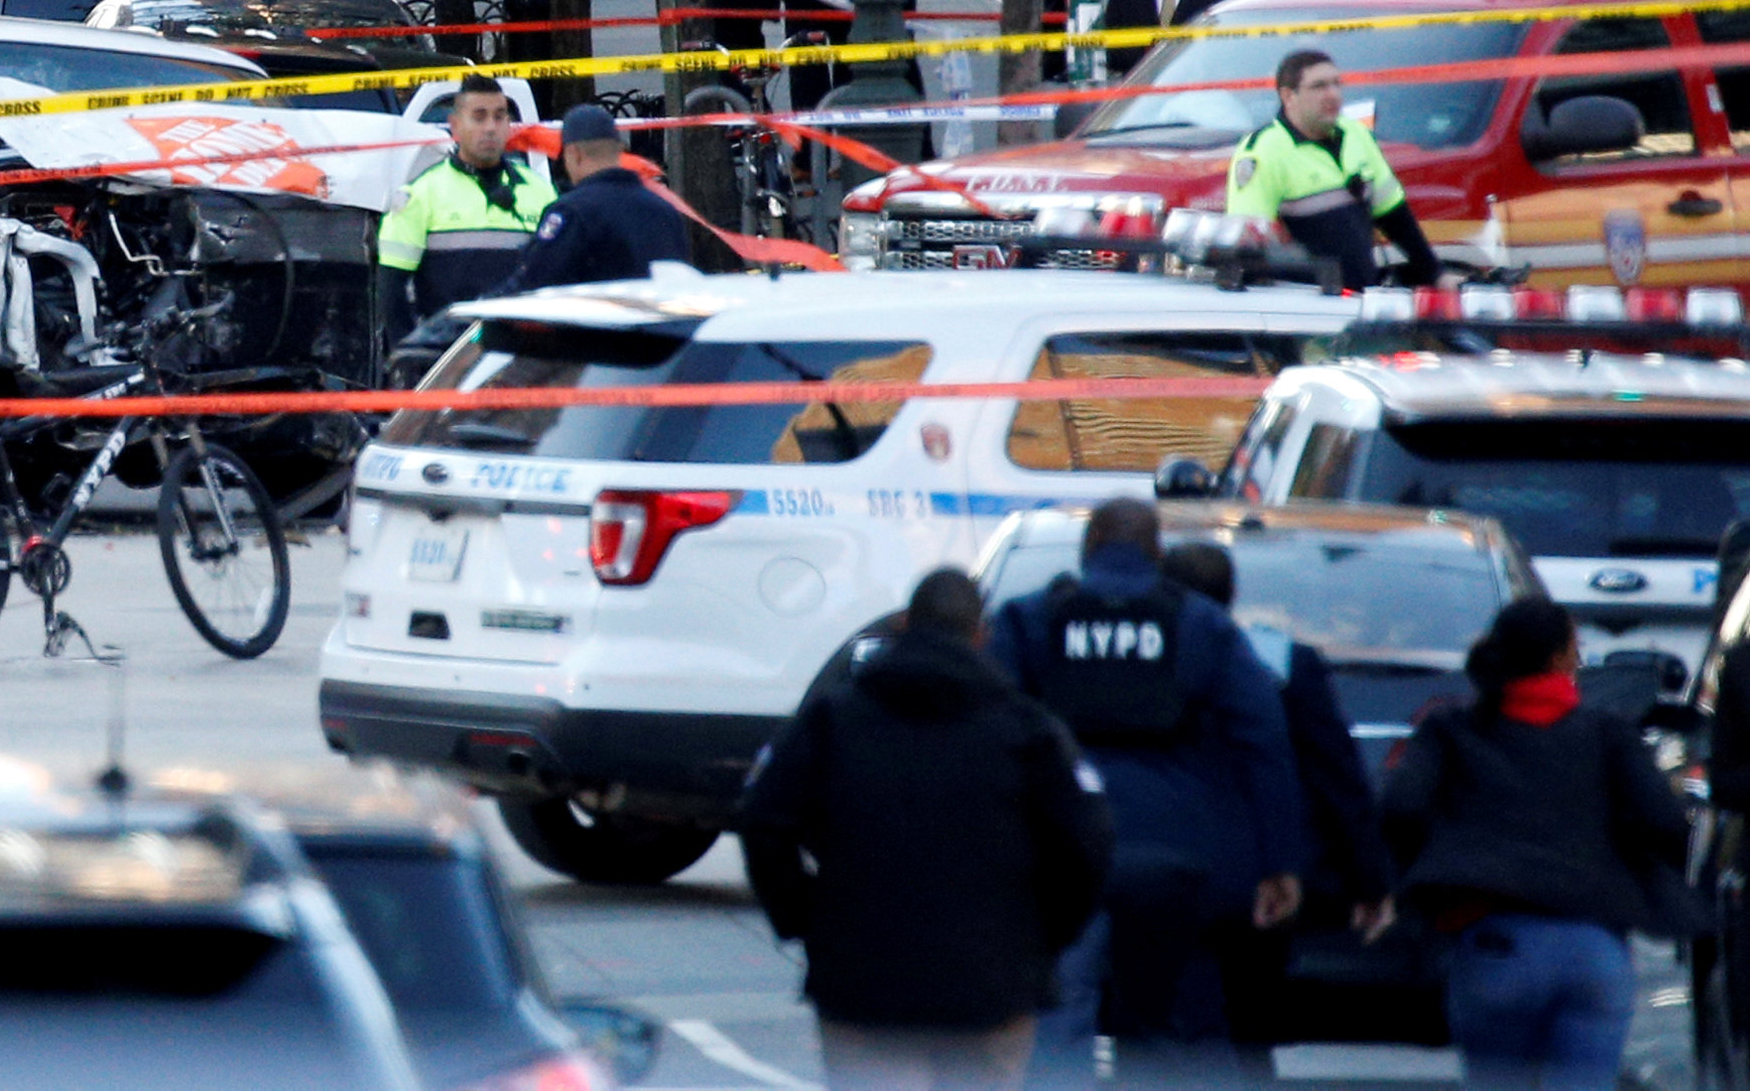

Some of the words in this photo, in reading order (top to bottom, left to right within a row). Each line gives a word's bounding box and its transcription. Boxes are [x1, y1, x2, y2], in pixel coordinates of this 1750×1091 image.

[353, 75, 396, 90] CRIME
[408, 72, 450, 85] SCENE
[529, 64, 577, 78] CROSS
[87, 95, 130, 110] CRIME
[142, 91, 184, 105] SCENE
[195, 88, 214, 102] DO
[226, 86, 253, 99] NOT
[263, 81, 309, 97] CROSS
[773, 488, 824, 516] 5520
[1064, 620, 1164, 660] NYPD
